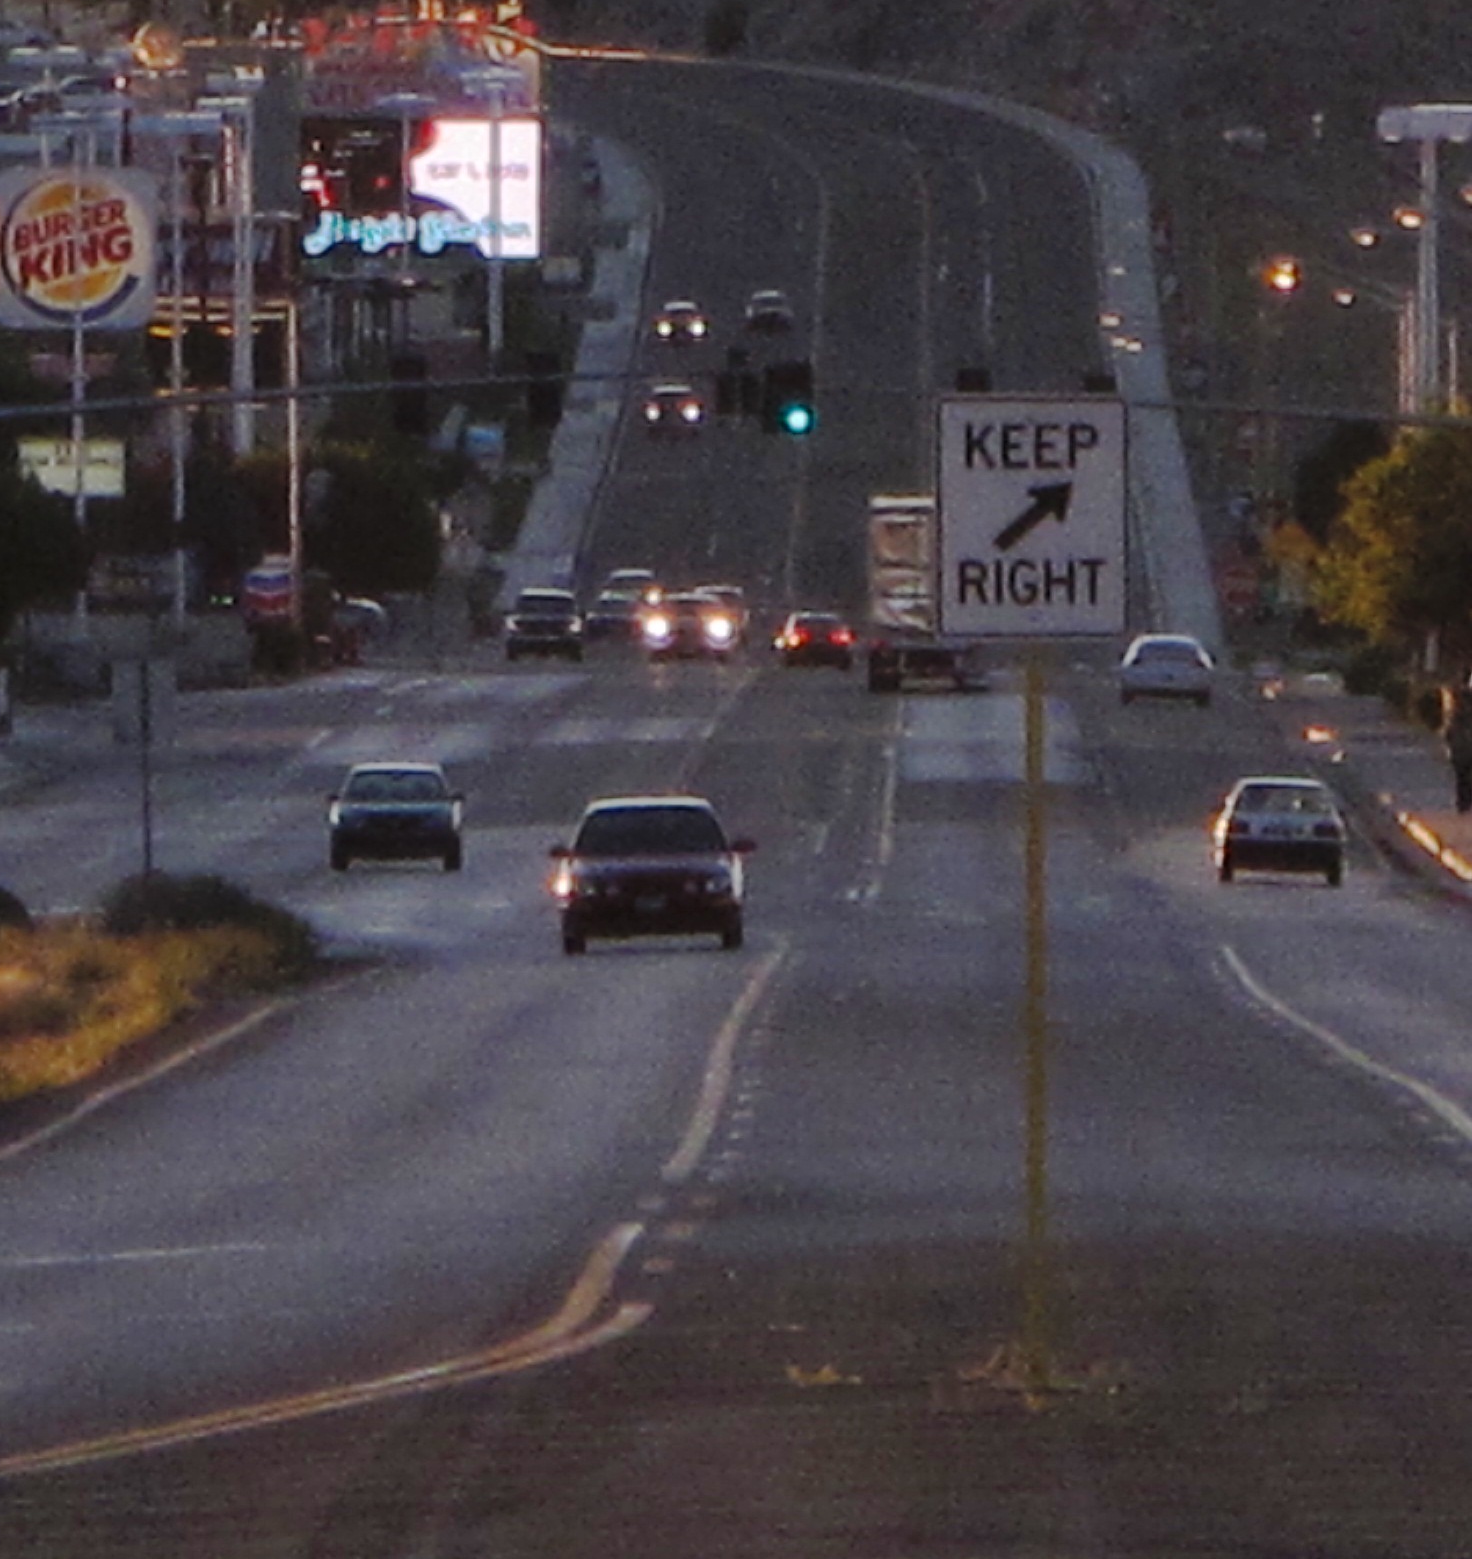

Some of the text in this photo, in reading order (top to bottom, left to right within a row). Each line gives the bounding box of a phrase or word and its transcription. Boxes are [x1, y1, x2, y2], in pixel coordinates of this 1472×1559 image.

[20, 226, 133, 289] KING
[964, 422, 1100, 471] KEEP
[957, 560, 1108, 606] RIGHT
